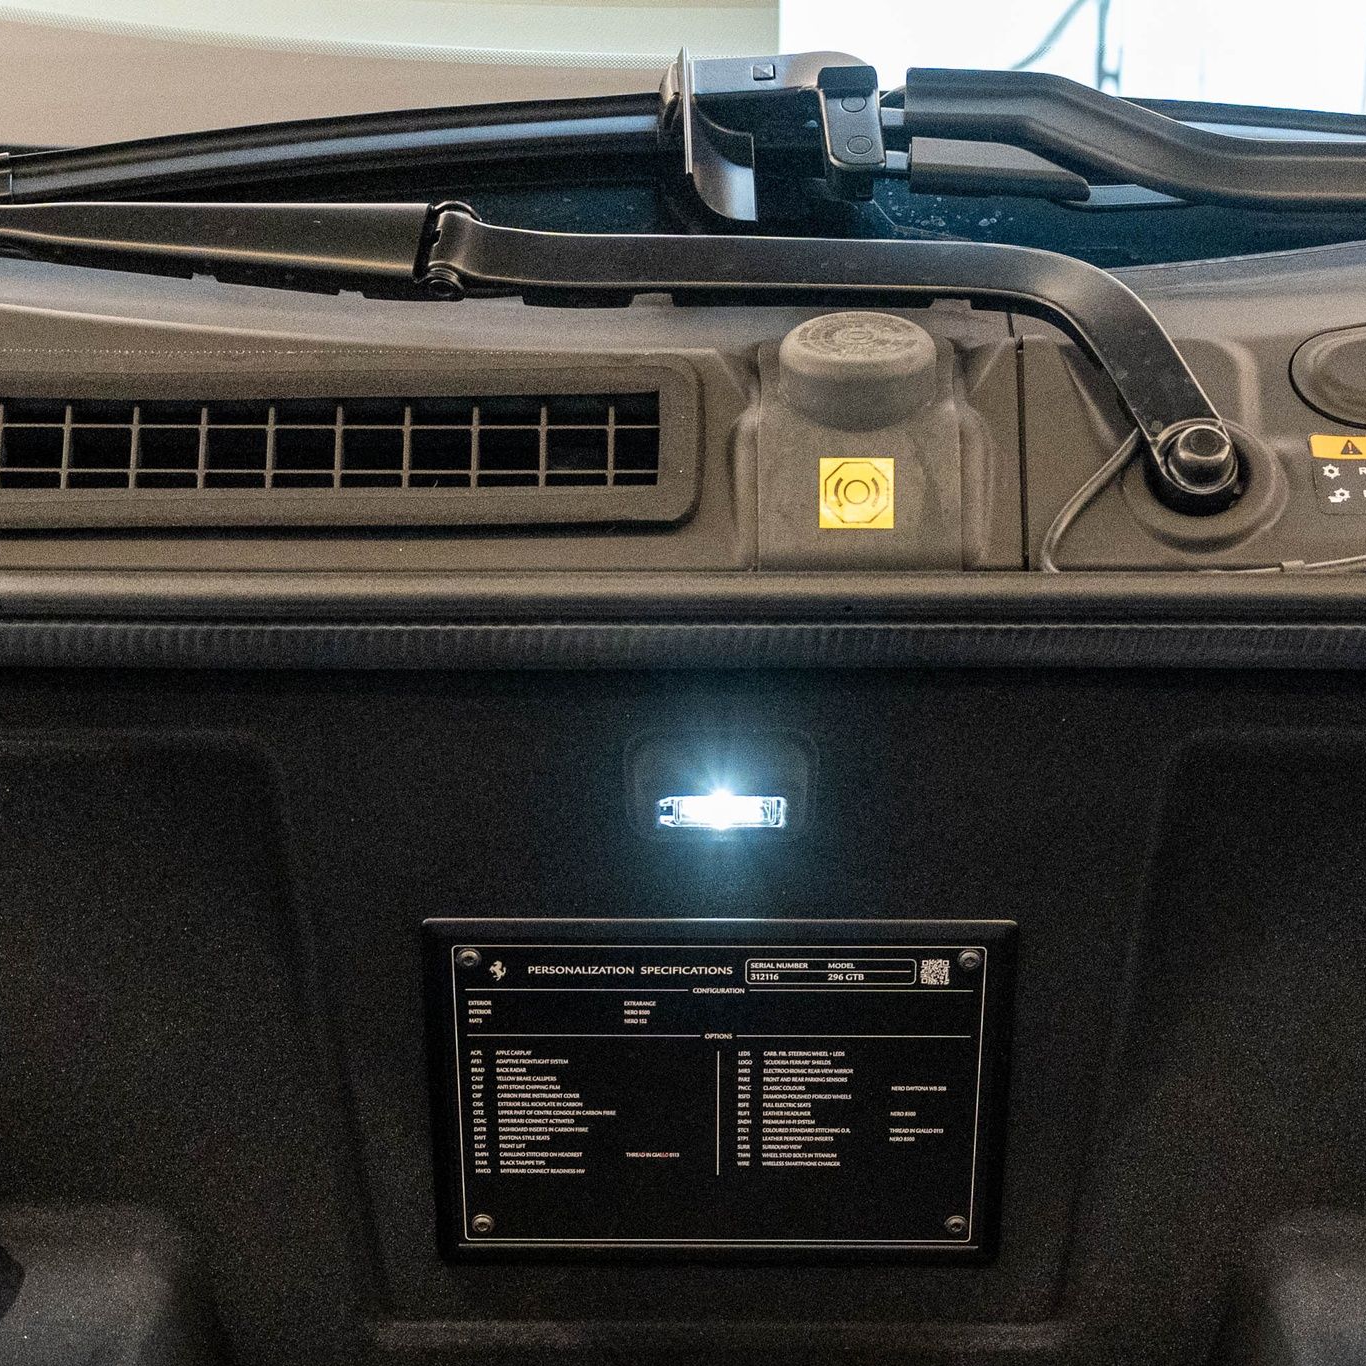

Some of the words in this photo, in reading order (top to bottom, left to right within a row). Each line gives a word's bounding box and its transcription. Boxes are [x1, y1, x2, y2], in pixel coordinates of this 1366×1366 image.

[528, 966, 634, 975] PERSONALIZATION
[640, 966, 733, 975] SPECIFICATIONS
[750, 973, 779, 981] 312116
[827, 973, 844, 981] 296
[845, 973, 865, 981] GTB
